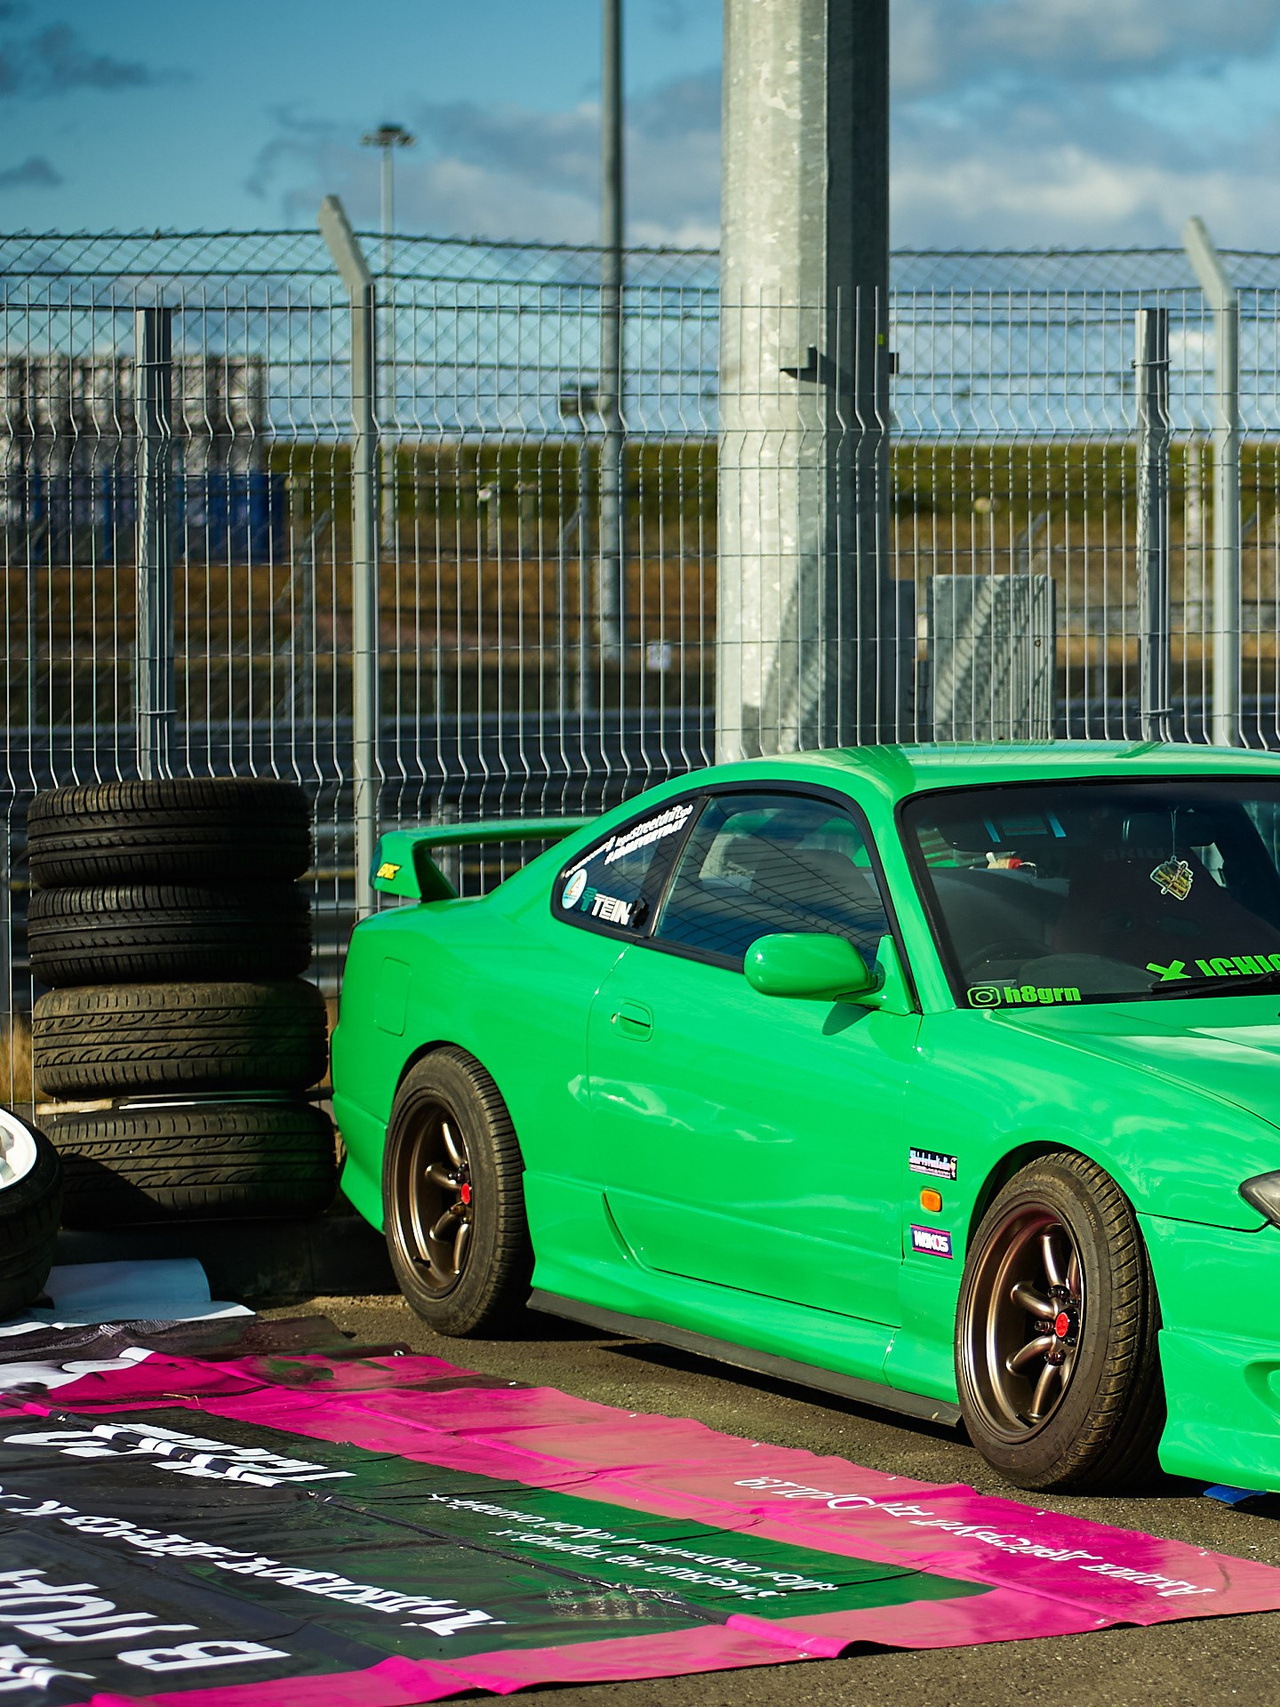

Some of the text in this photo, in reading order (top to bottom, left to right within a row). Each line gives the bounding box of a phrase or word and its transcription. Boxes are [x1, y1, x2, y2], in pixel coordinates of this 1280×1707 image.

[591, 894, 633, 926] TEIN
[1004, 984, 1081, 1005] h8grn
[1078, 1562, 1216, 1598] Акция
